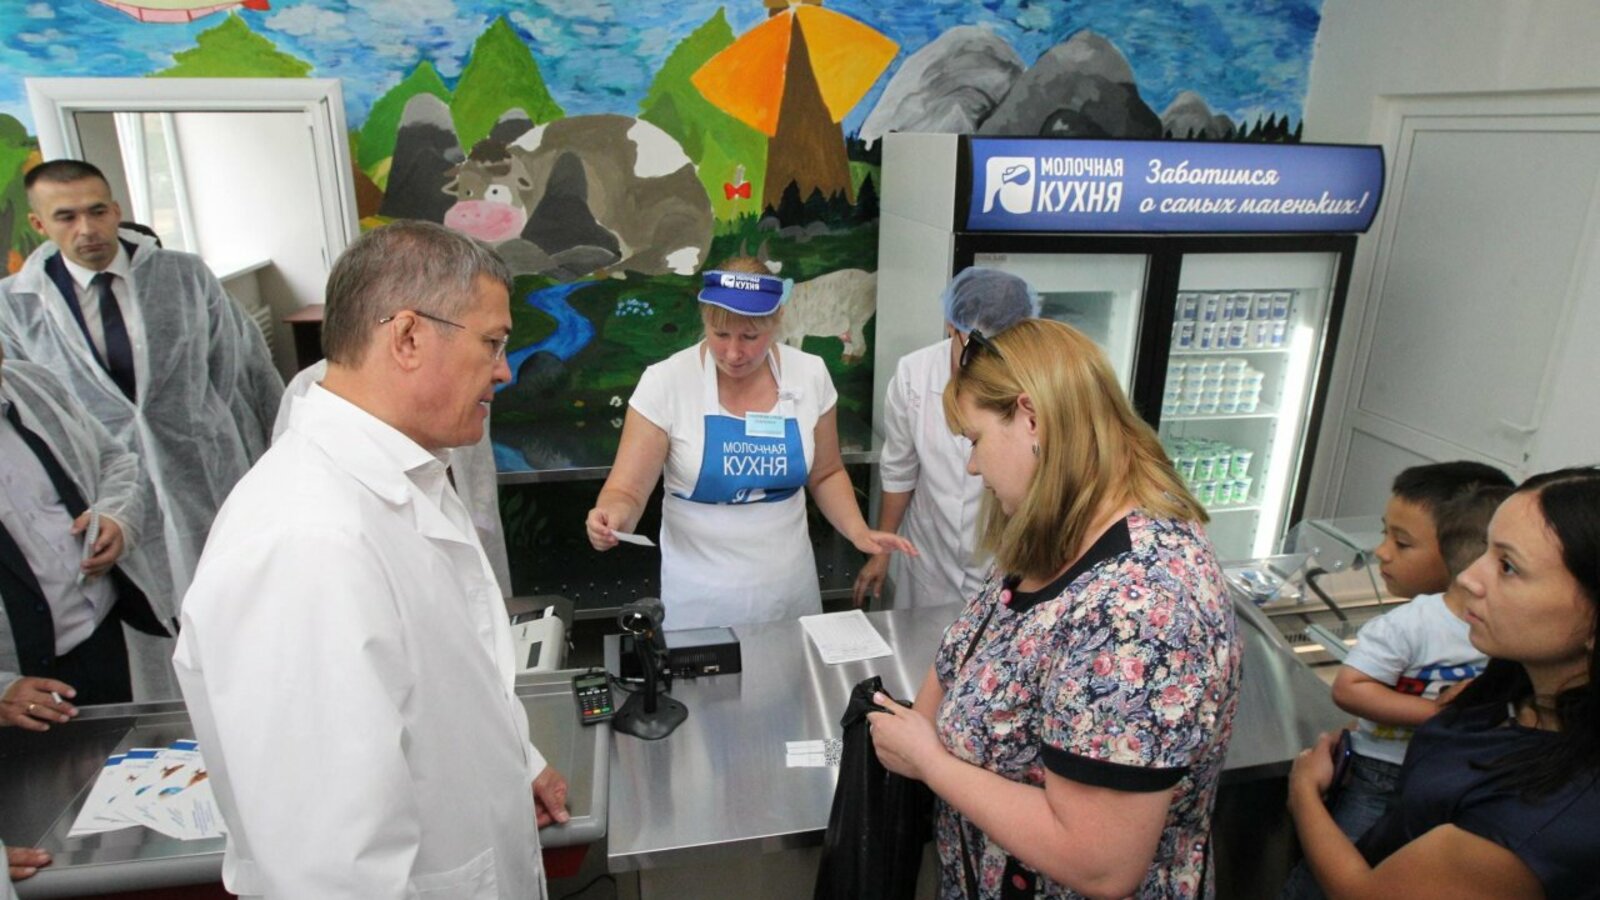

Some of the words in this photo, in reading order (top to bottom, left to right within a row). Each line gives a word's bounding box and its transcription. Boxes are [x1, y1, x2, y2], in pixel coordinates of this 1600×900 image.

[1040, 157, 1124, 177] МОЛОЧНАЯ
[1145, 158, 1280, 186] Заботимся
[1036, 180, 1124, 213] КУХНЯ
[1139, 197, 1156, 213] о
[1160, 197, 1237, 214] самых
[1238, 191, 1369, 215] маленьких!
[723, 441, 787, 454] МОЛОЧНАЯ
[723, 455, 788, 476] КУХНЯ
